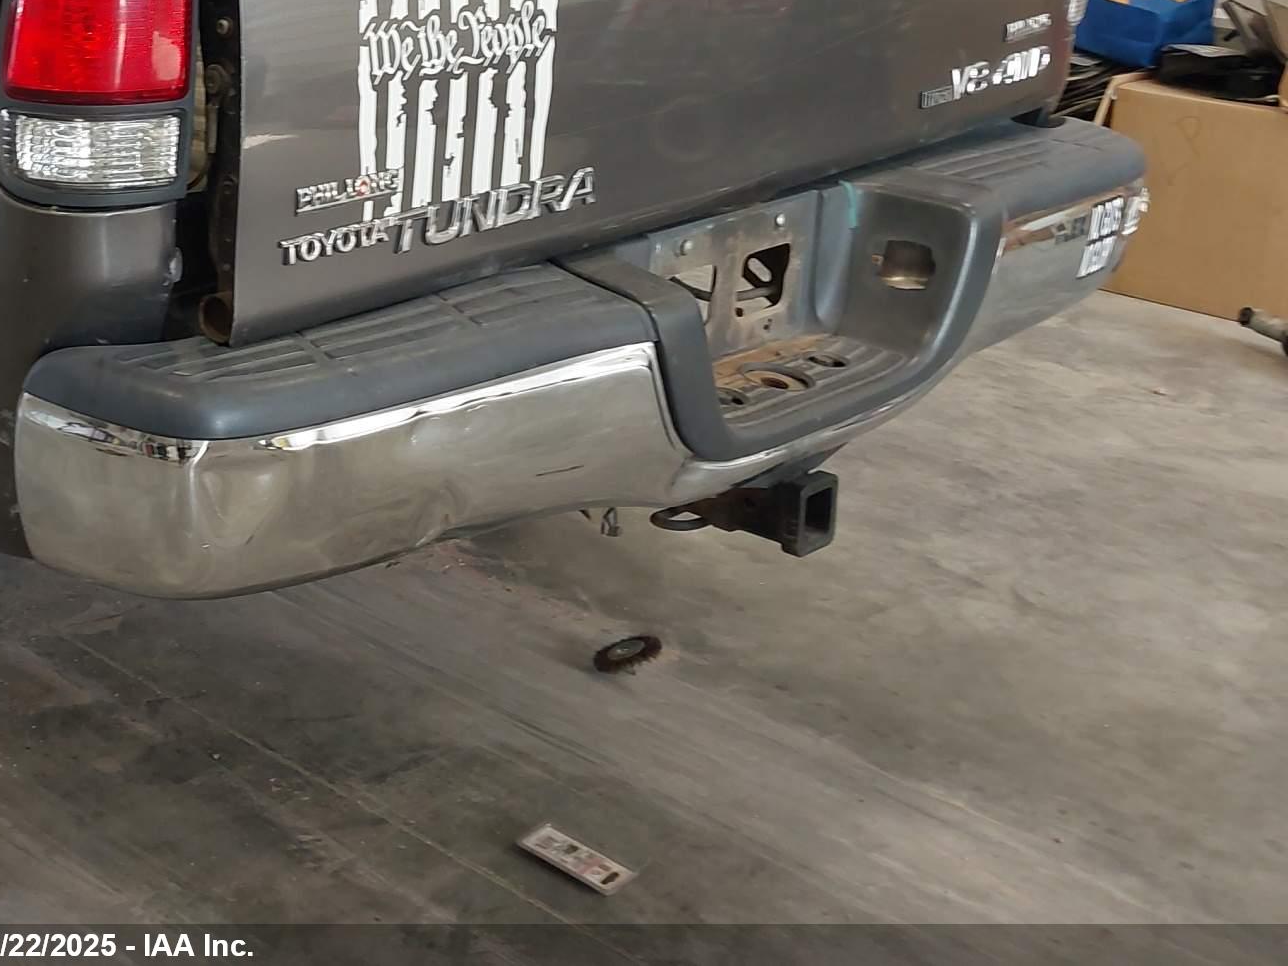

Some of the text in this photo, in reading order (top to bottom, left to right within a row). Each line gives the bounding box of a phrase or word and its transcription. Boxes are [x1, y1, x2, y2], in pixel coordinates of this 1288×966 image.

[363, 0, 551, 85] We the People
[277, 165, 597, 266] TOYOTA TUNDRA
